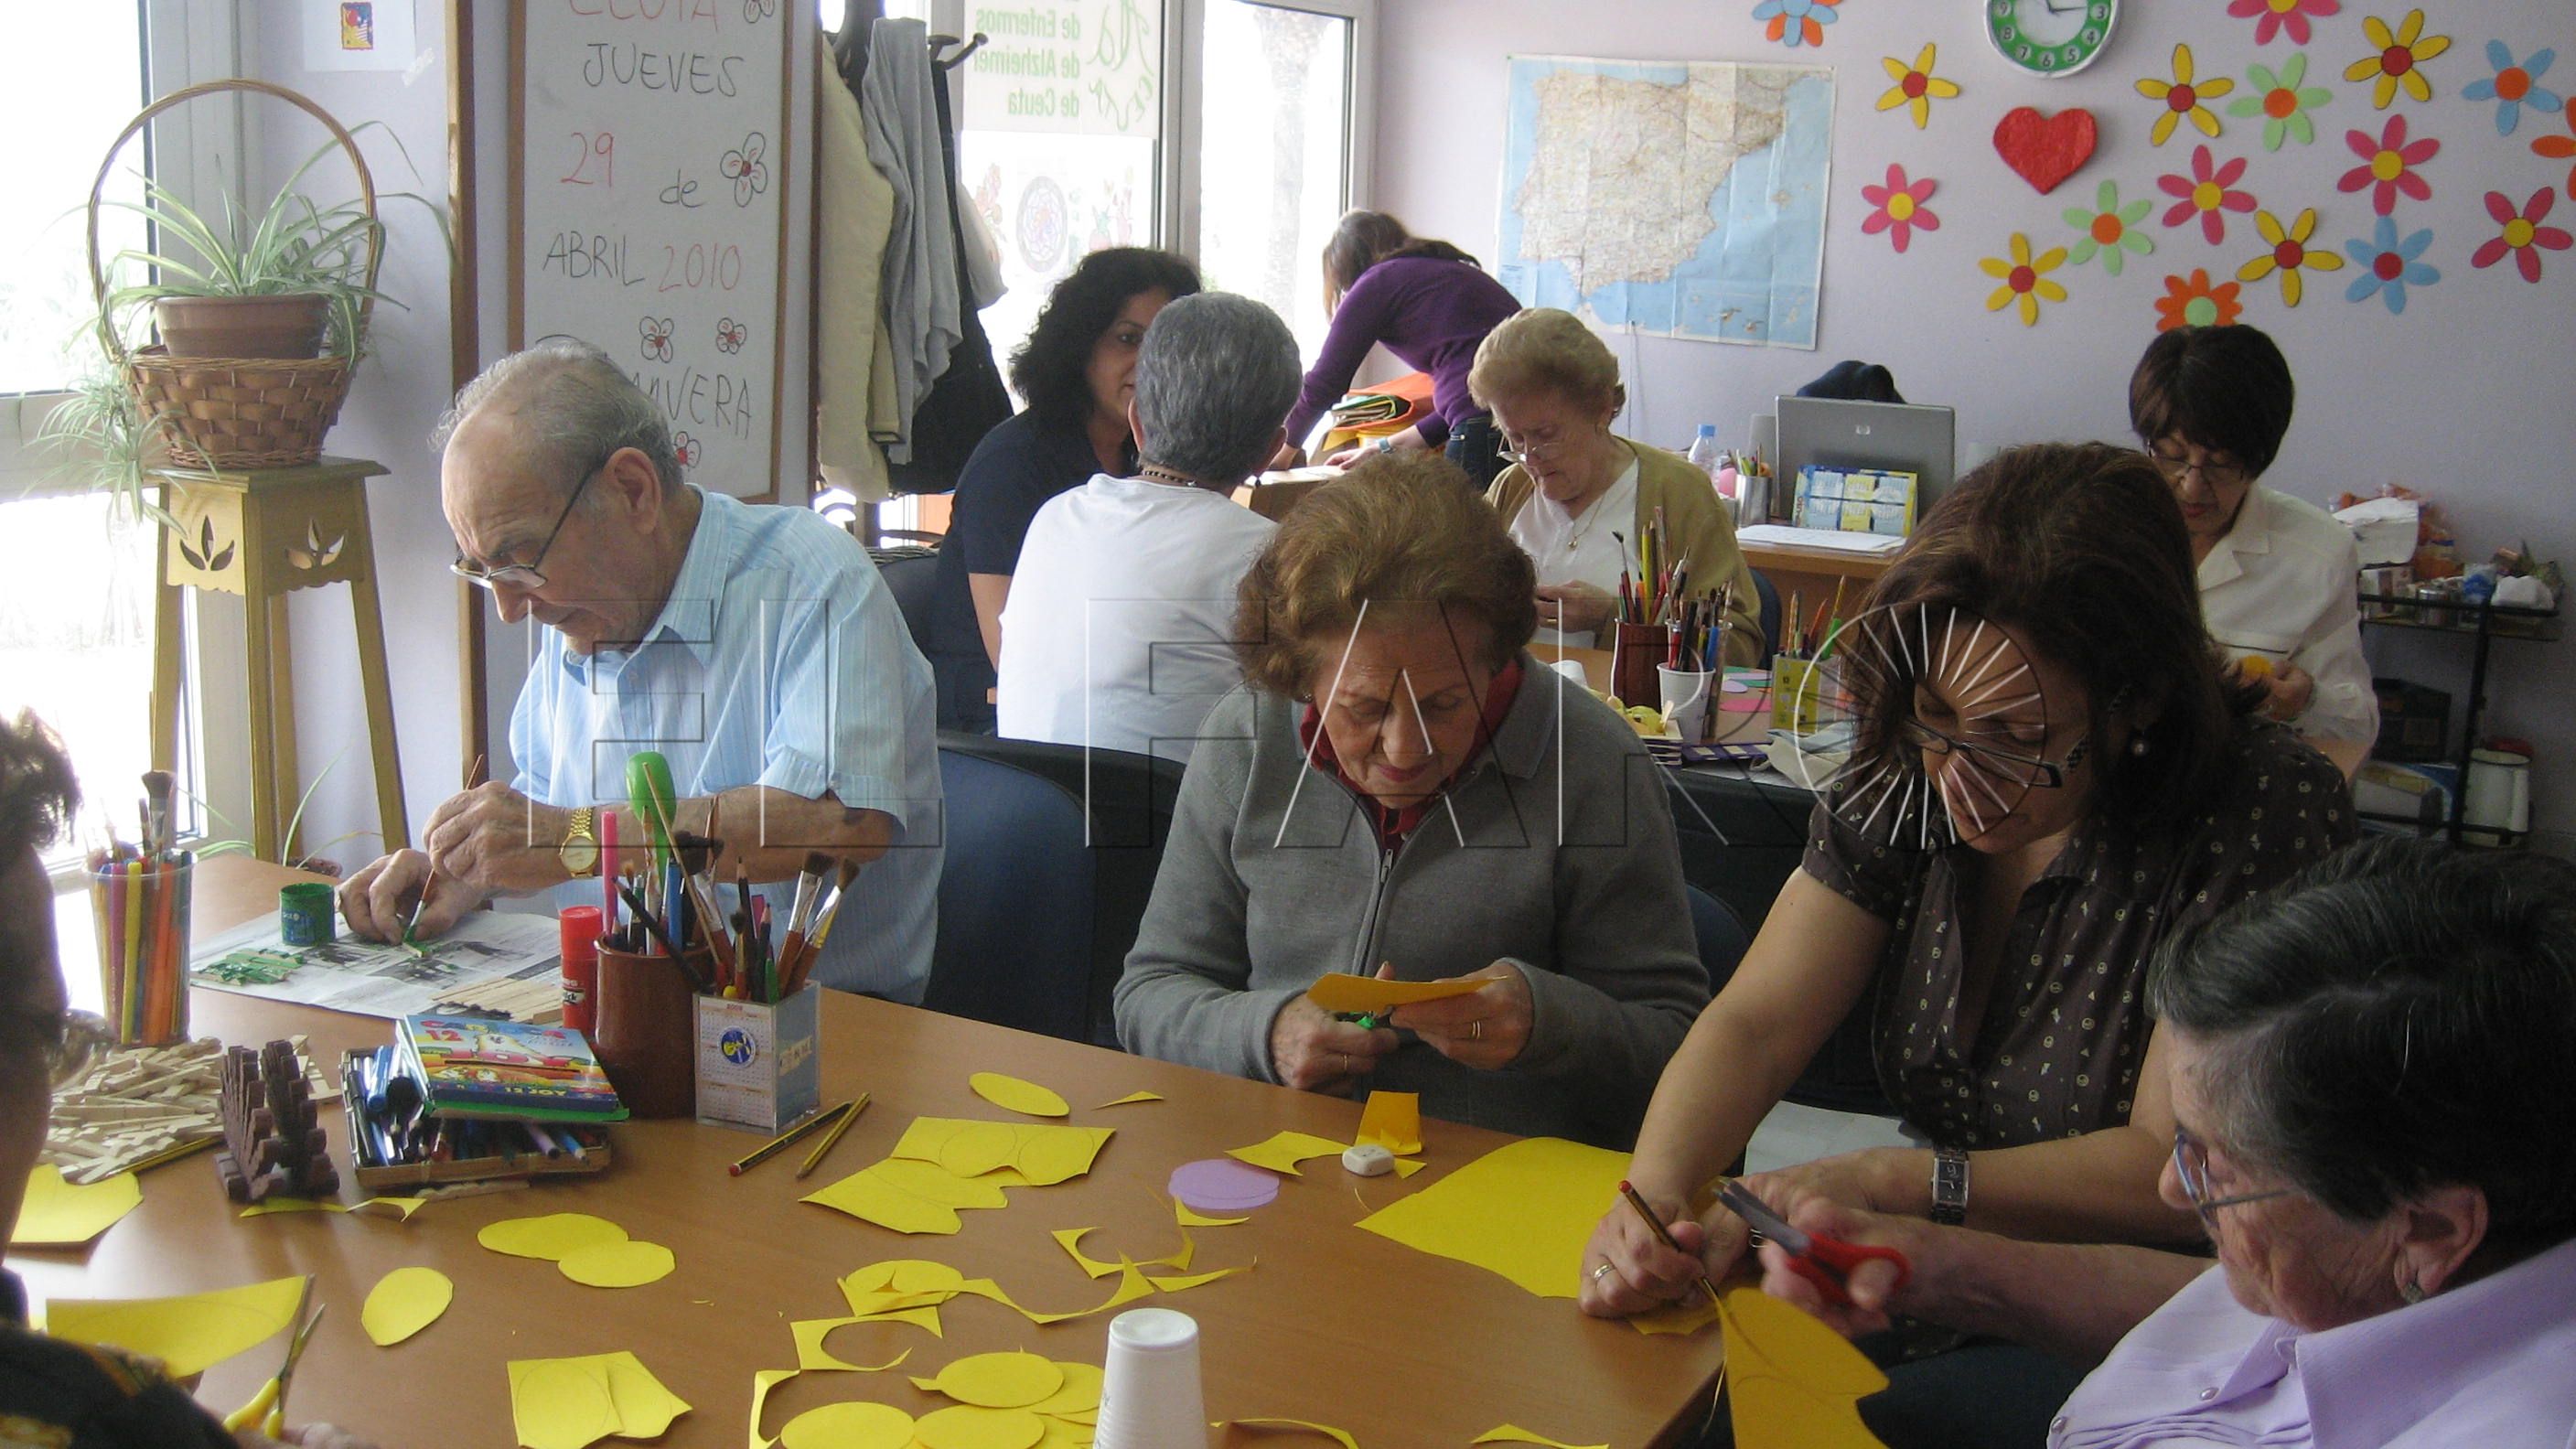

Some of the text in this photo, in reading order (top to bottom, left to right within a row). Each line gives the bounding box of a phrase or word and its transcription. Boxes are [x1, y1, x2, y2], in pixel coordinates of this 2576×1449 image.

[2097, 6, 2105, 18] 3
[2003, 27, 2012, 40] 8
[2087, 30, 2096, 44] 4
[2020, 46, 2028, 58] 7
[2067, 48, 2077, 62] 5
[2043, 54, 2051, 67] 6
[583, 43, 744, 97] JUEVES
[560, 132, 705, 209] 29 de
[542, 231, 742, 293] ABRIL 2010
[425, 1029, 464, 1042] 12
[528, 1087, 566, 1098] JOY
